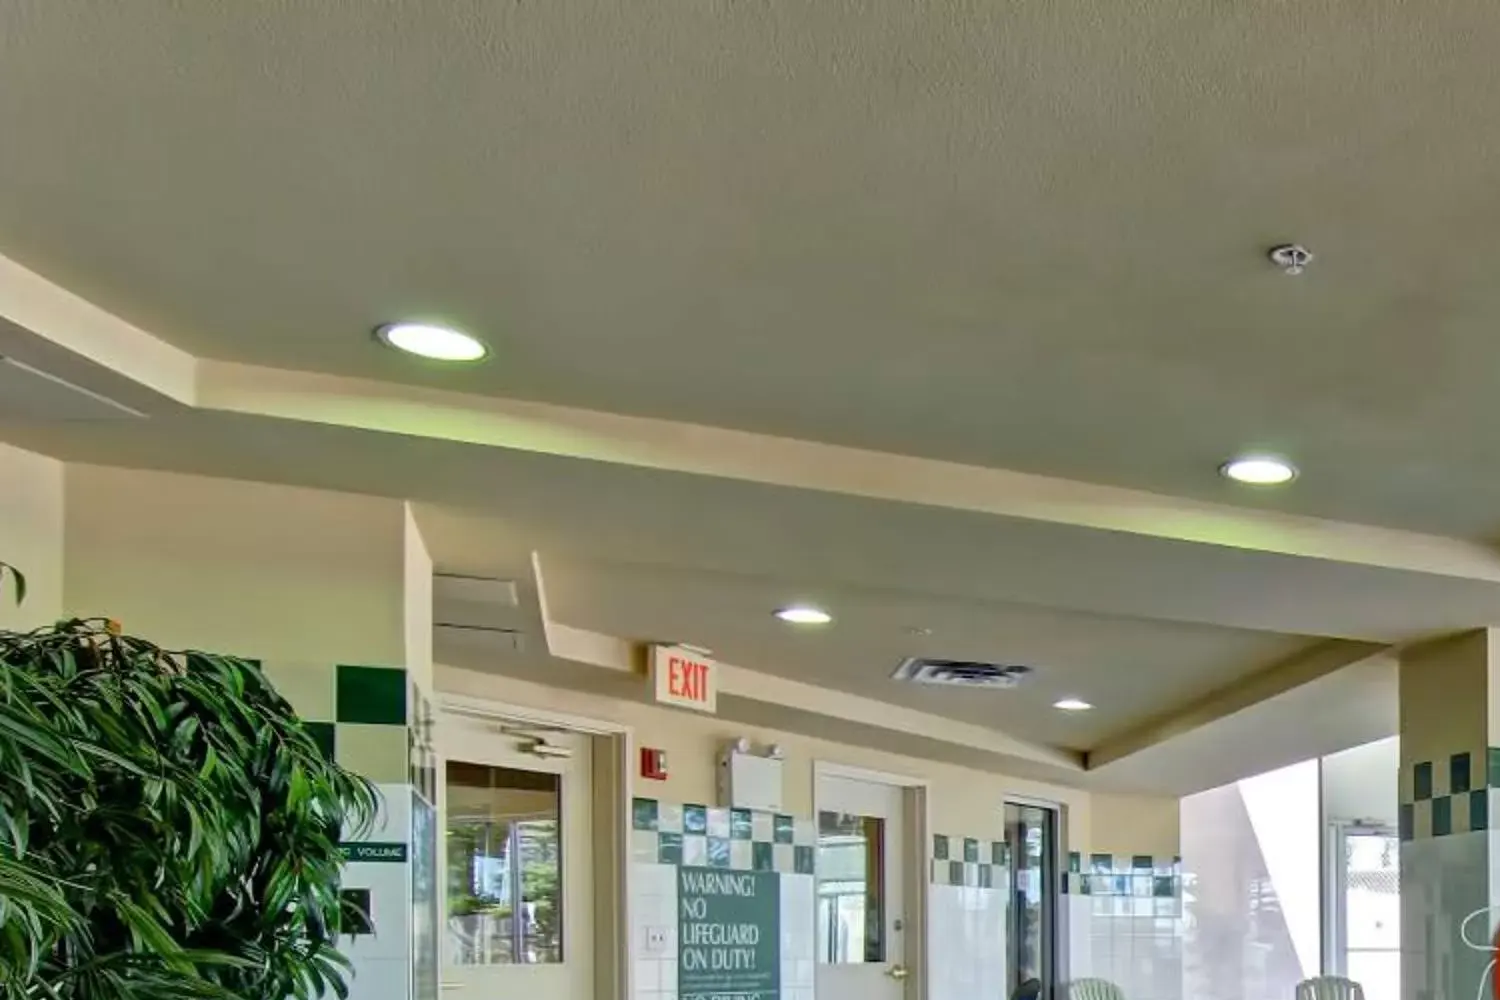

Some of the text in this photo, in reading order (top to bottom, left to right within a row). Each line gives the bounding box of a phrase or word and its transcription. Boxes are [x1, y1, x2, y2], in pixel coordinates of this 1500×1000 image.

[668, 657, 709, 702] EXIT
[681, 872, 755, 896] WARNING!
[682, 898, 706, 919] NO
[682, 923, 759, 945] LIFEGUARD
[683, 948, 756, 970] ON DUTY!
